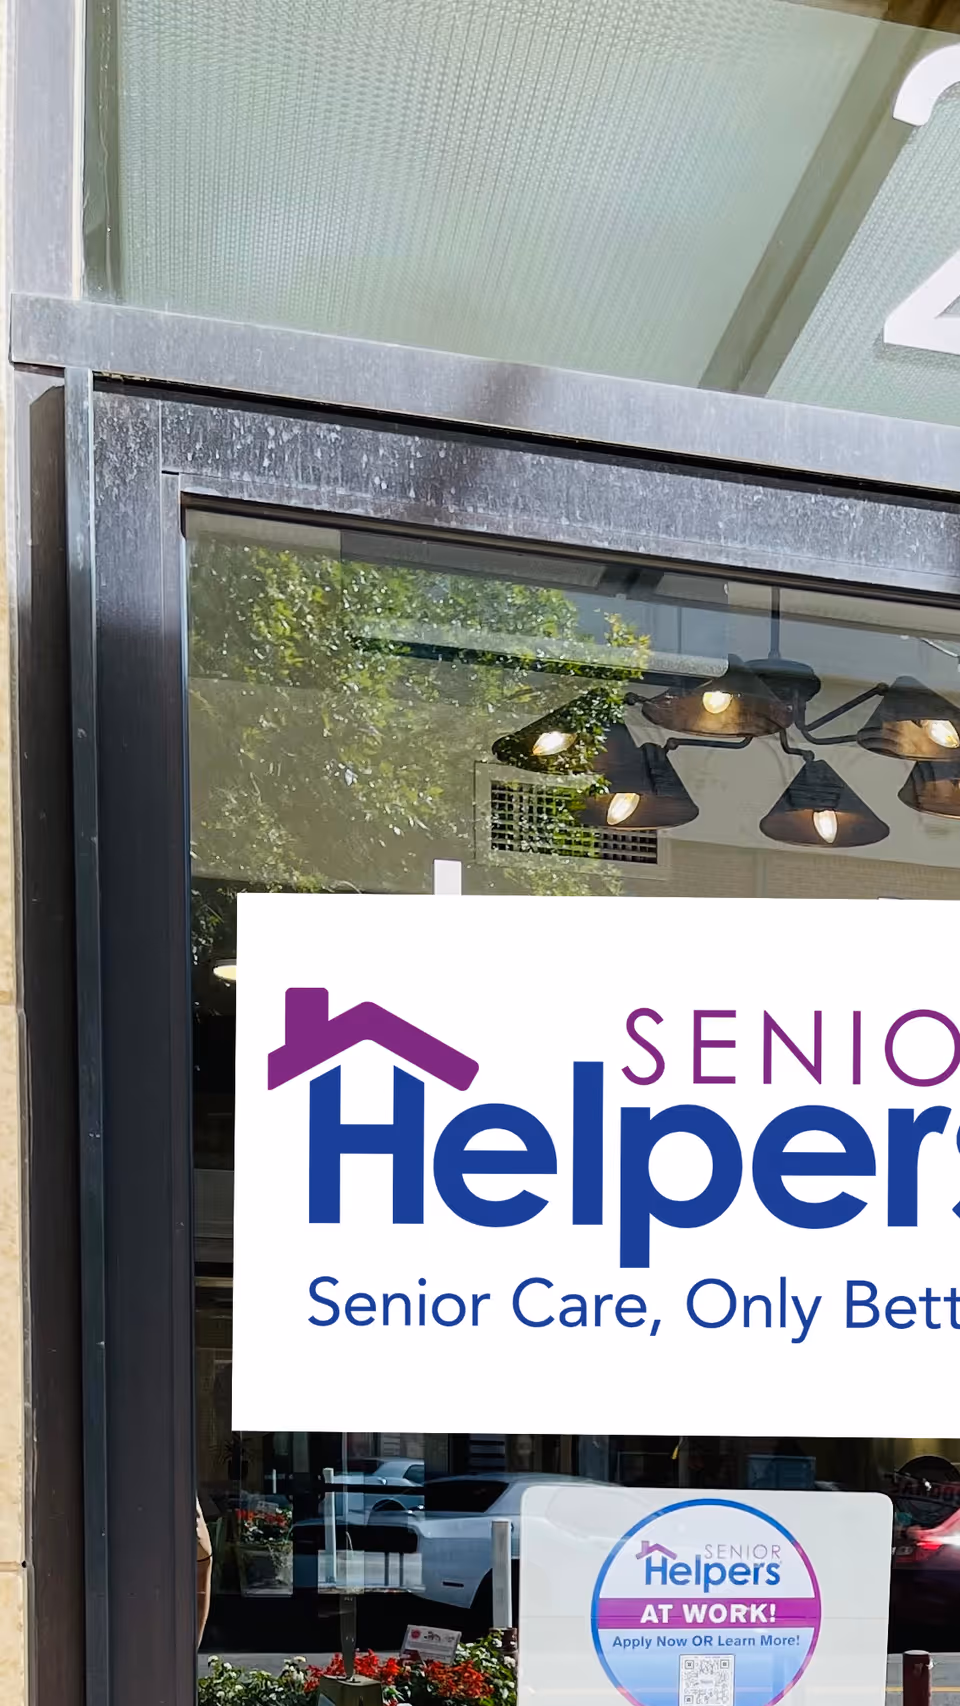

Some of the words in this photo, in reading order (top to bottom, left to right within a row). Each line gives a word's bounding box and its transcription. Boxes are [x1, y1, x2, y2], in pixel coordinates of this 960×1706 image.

[308, 1276, 490, 1327] Senior
[513, 1277, 661, 1336] Care,
[687, 1277, 822, 1343] Only
[704, 1543, 782, 1560] SENIOR
[645, 1554, 781, 1593] Helpers
[640, 1603, 673, 1624] AT
[682, 1603, 777, 1624] WORK!
[612, 1635, 653, 1650] Apply
[656, 1635, 688, 1647] Now
[692, 1634, 713, 1648] OR
[718, 1635, 756, 1647] Learn
[760, 1634, 801, 1647] More!
